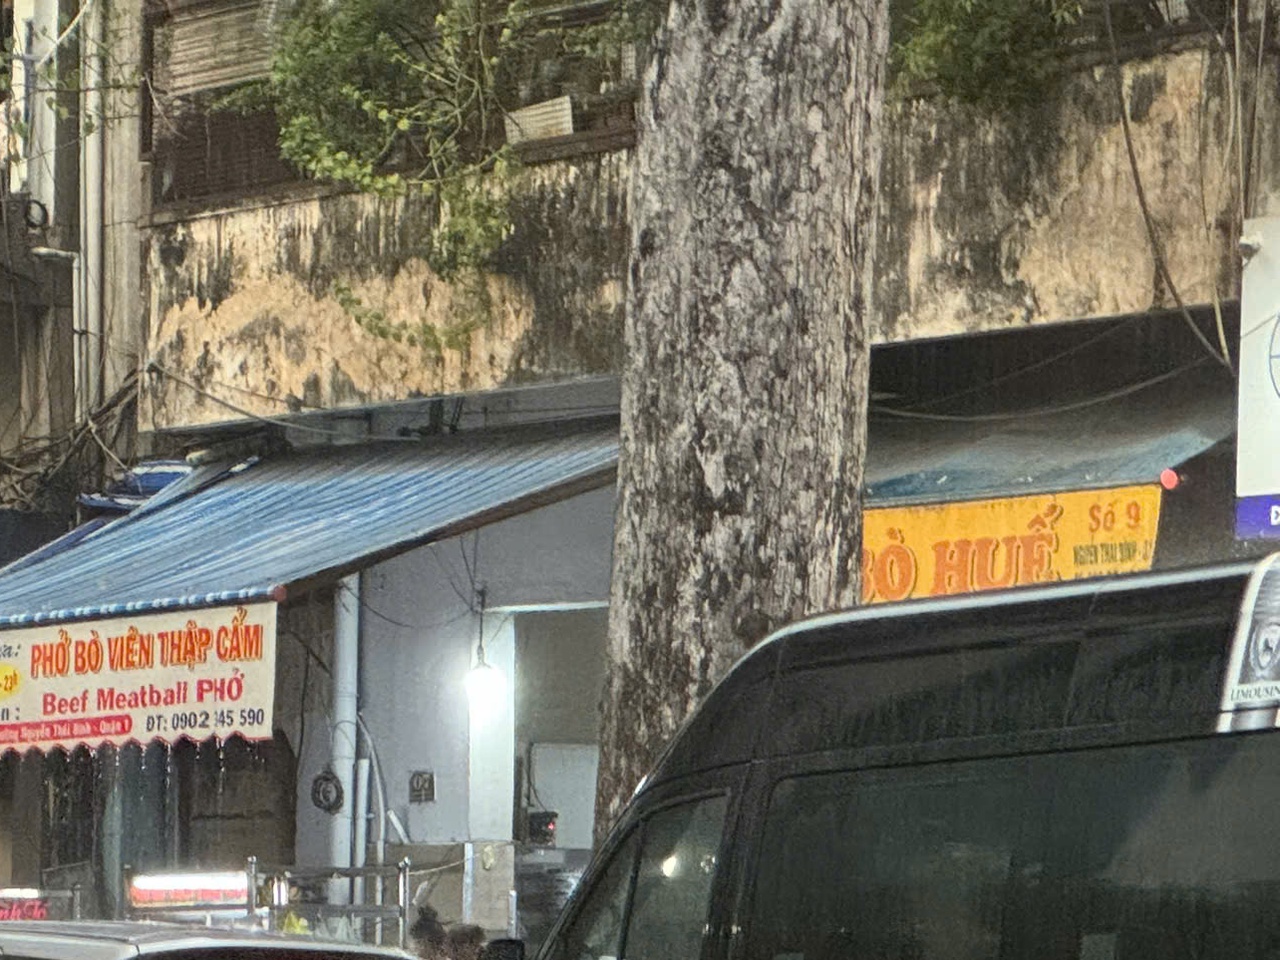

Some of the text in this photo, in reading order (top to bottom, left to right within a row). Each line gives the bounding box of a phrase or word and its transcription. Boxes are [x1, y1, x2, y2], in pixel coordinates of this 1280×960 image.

[1126, 501, 1141, 530] 9
[932, 503, 1063, 597] HUẾ
[74, 630, 103, 674] BÒ
[107, 625, 154, 670] VIÊN
[157, 620, 213, 671] THẬP
[43, 690, 89, 715] Beef
[97, 682, 187, 710] Meatball
[172, 711, 209, 729] 0902
[240, 708, 265, 726] 590
